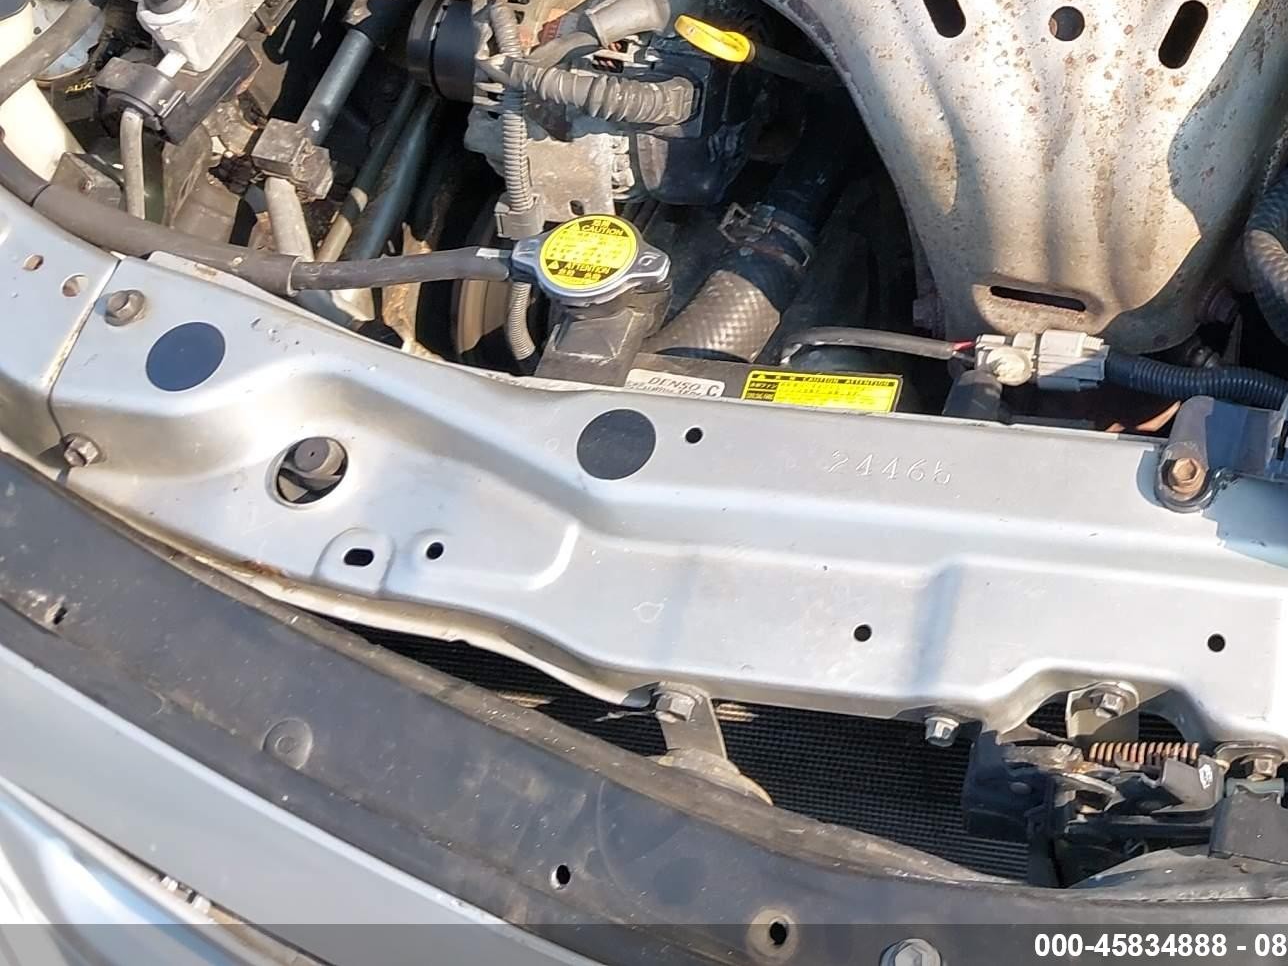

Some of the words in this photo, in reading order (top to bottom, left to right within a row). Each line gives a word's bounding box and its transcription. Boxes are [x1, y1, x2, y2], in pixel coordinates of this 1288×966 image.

[581, 224, 624, 236] CAUTION
[563, 262, 611, 275] ATTENTION
[647, 376, 701, 392] DENSO
[706, 384, 720, 397] C
